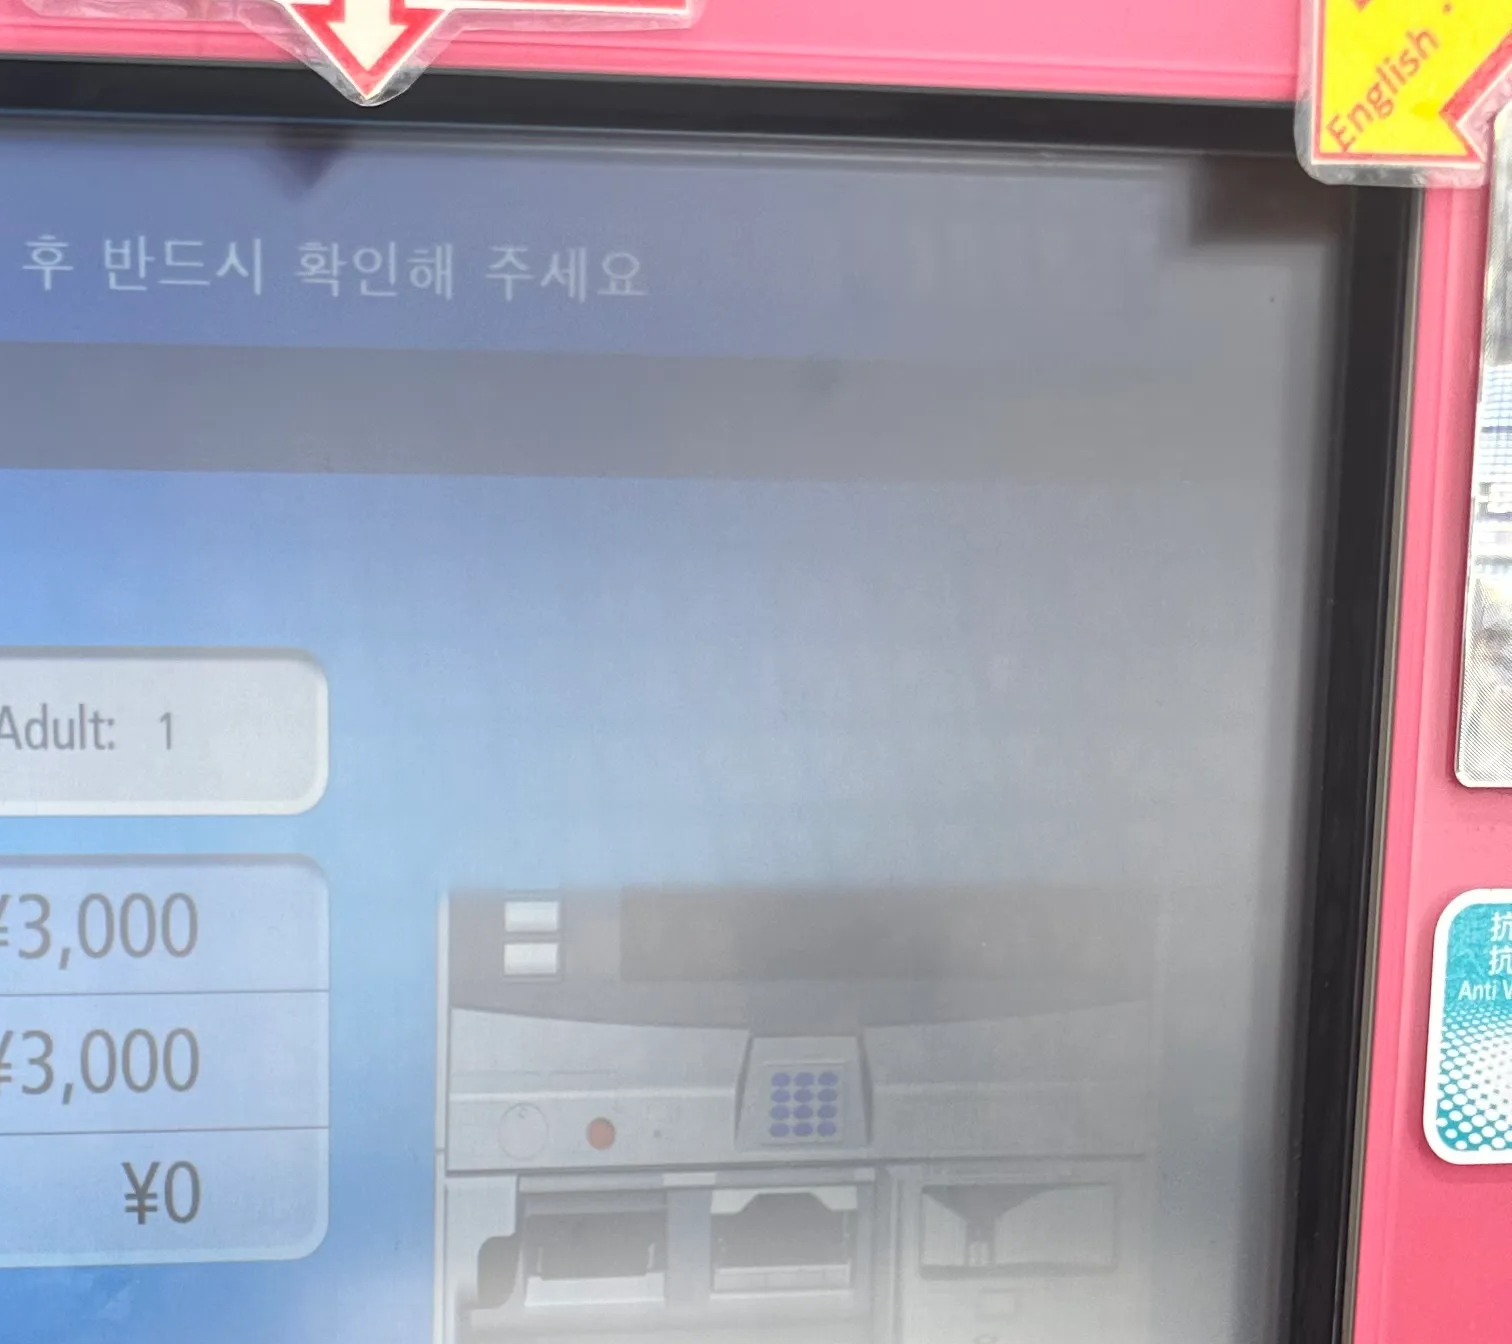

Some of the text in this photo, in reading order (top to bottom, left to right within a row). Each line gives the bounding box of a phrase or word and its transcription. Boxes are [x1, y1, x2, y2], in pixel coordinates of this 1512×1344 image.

[1326, 29, 1440, 152] English
[21, 234, 73, 292] 후
[104, 238, 263, 296] 반드시
[297, 241, 455, 300] 확인해
[486, 245, 648, 303] 주세요
[158, 711, 174, 750] 1
[1458, 980, 1497, 1001] Anti
[122, 1160, 201, 1226] ¥0
